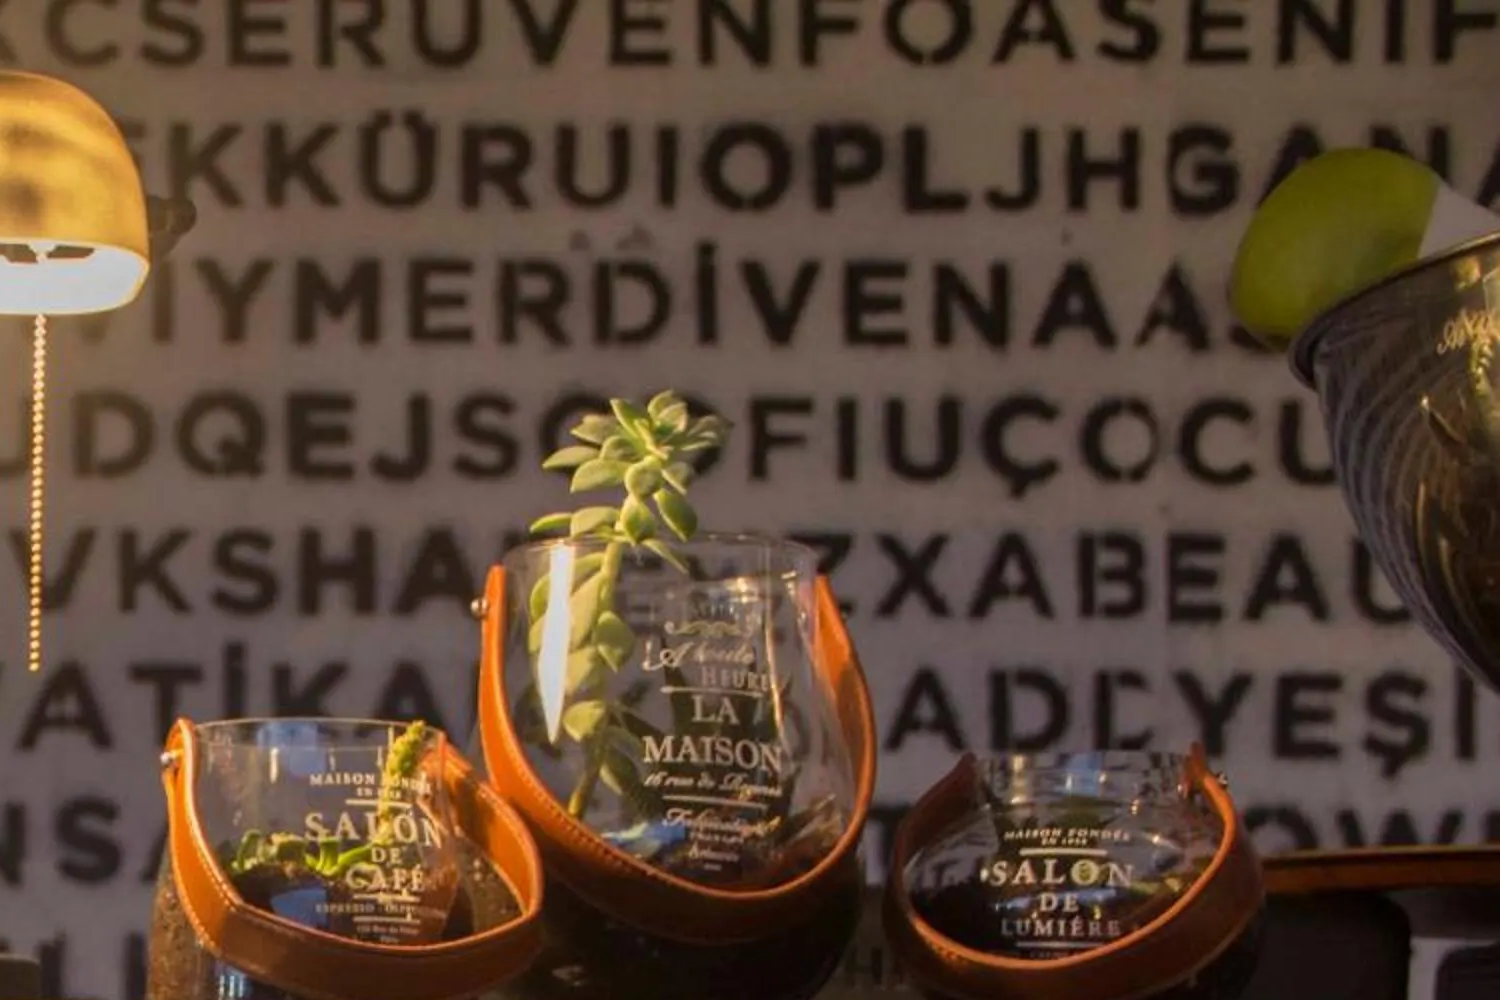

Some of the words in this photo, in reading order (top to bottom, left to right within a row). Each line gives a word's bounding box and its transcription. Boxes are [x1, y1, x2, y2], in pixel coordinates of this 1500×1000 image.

[691, 693, 741, 726] LA
[642, 735, 783, 775] MAISON
[309, 771, 376, 787] MAISON
[304, 812, 443, 850] SALON
[1003, 828, 1063, 842] MAISON
[371, 847, 404, 865] DE
[345, 862, 426, 893] CAFÉ
[989, 858, 1135, 888] SALON
[1039, 892, 1081, 912] DE
